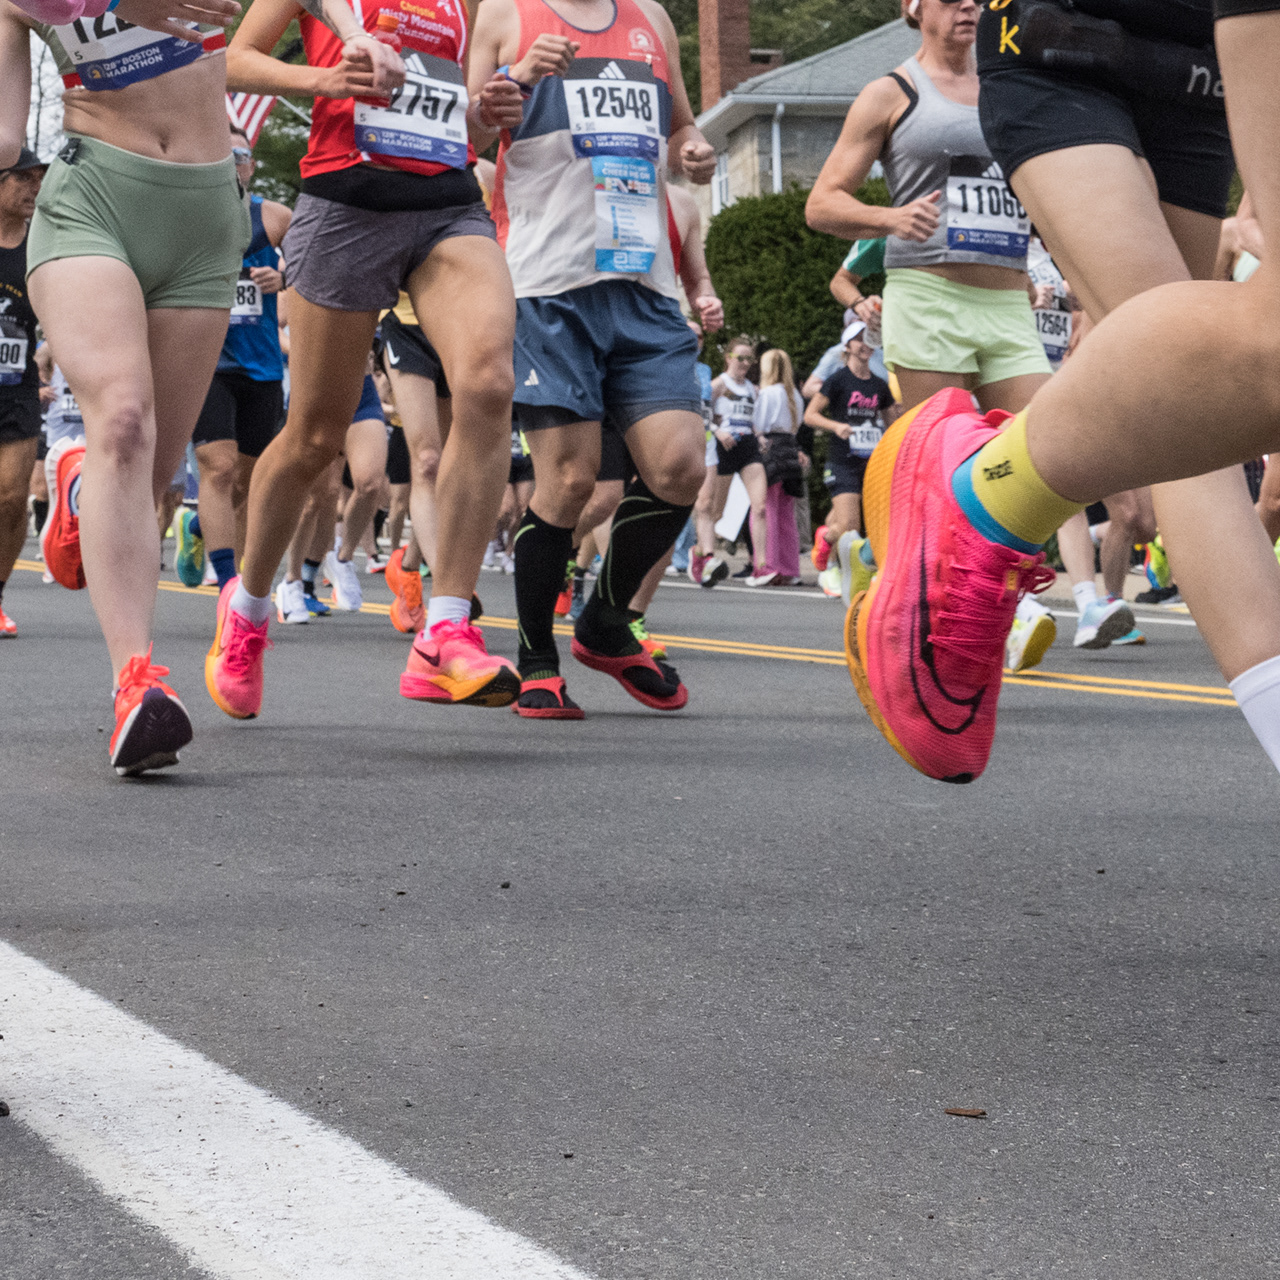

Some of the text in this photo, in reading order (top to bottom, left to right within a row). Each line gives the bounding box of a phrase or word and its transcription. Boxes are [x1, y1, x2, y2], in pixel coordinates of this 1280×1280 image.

[999, 16, 1020, 55] k
[74, 50, 84, 61] 5
[105, 54, 163, 78] MARATHON
[121, 46, 160, 65] BOSTON
[371, 79, 458, 124] 2757
[576, 85, 652, 121] 12548
[360, 113, 366, 122] 5
